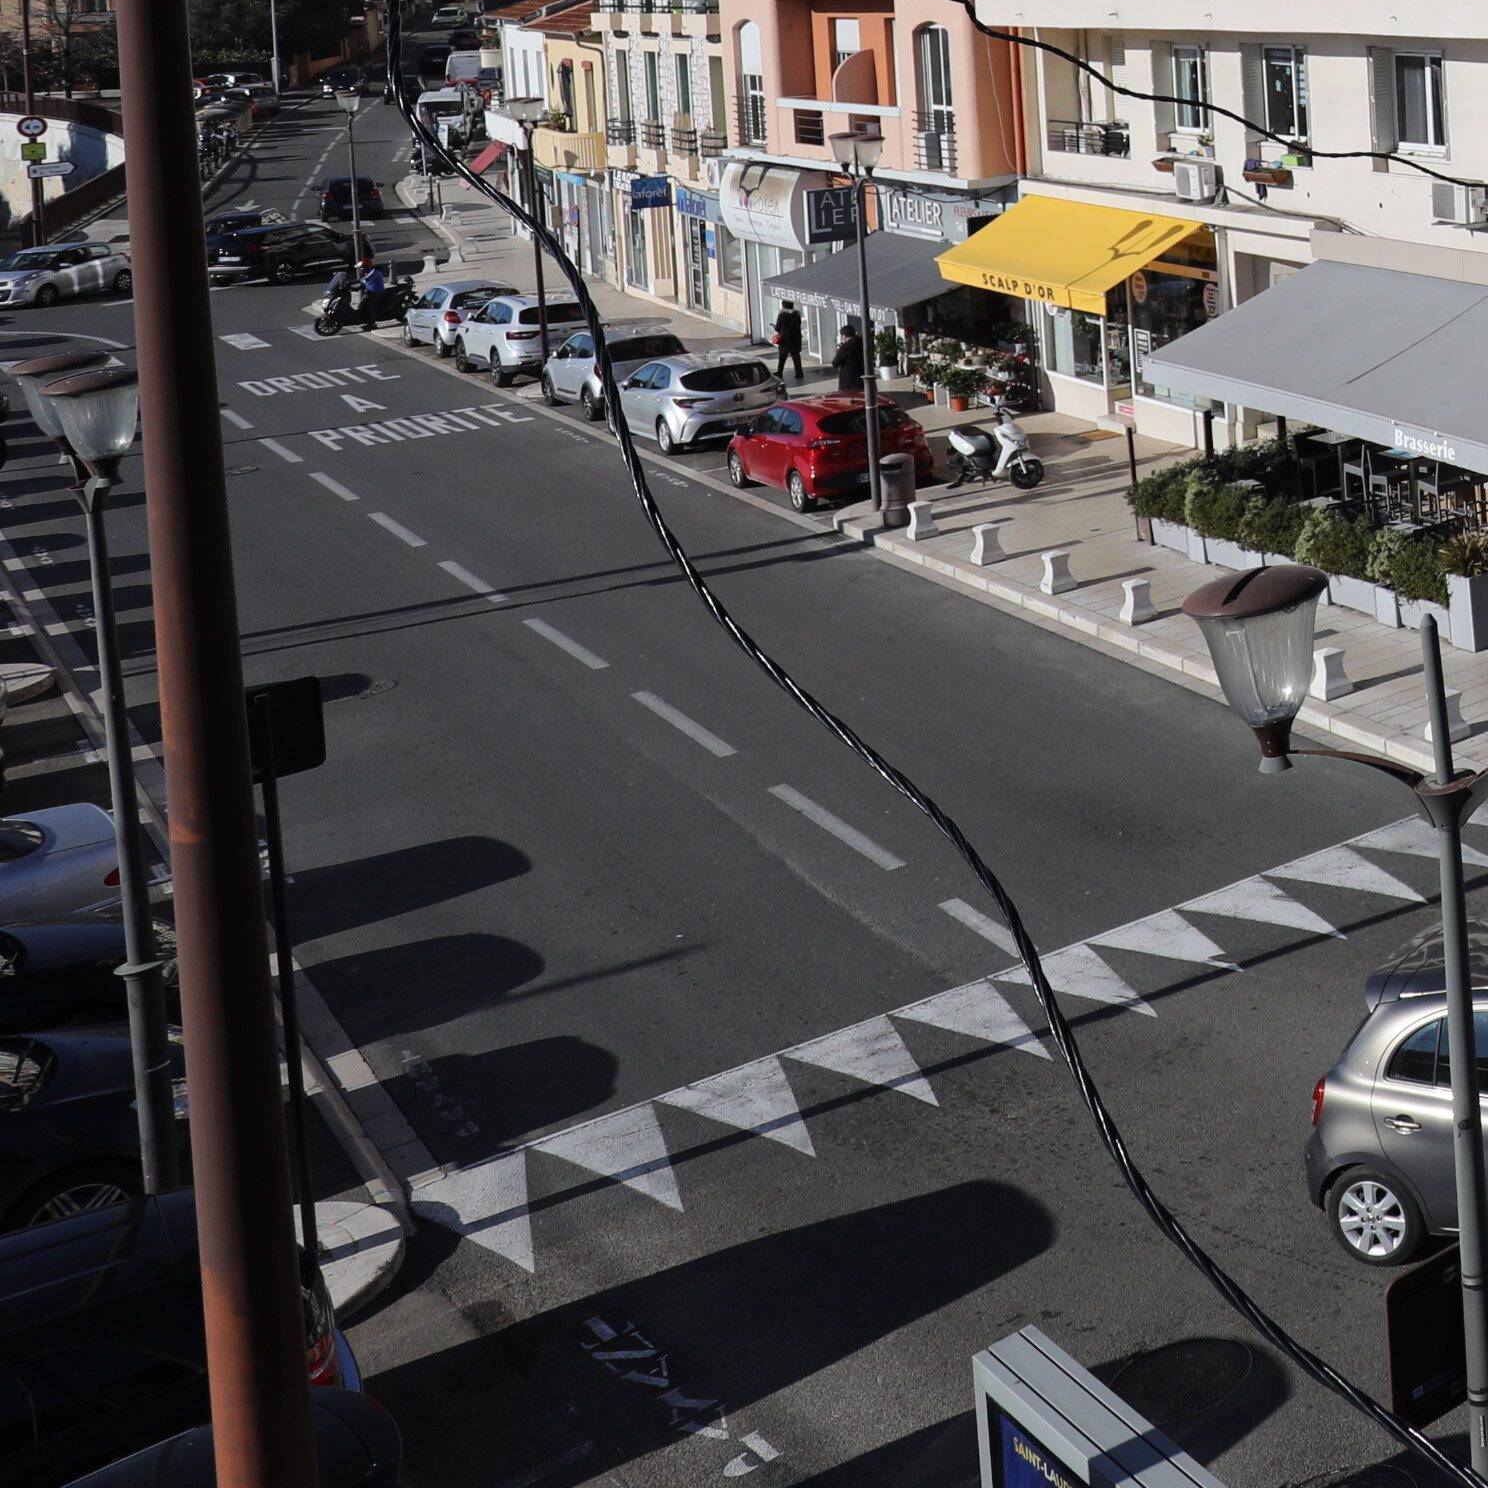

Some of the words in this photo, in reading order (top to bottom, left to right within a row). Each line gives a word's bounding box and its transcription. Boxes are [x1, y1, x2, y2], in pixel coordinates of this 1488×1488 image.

[982, 272, 1018, 297] SCALP
[1024, 282, 1055, 301] D'OR
[237, 364, 402, 397] DROITE
[341, 394, 387, 413] A
[307, 403, 536, 451] PRIORITE
[1394, 428, 1457, 462] Brasserie
